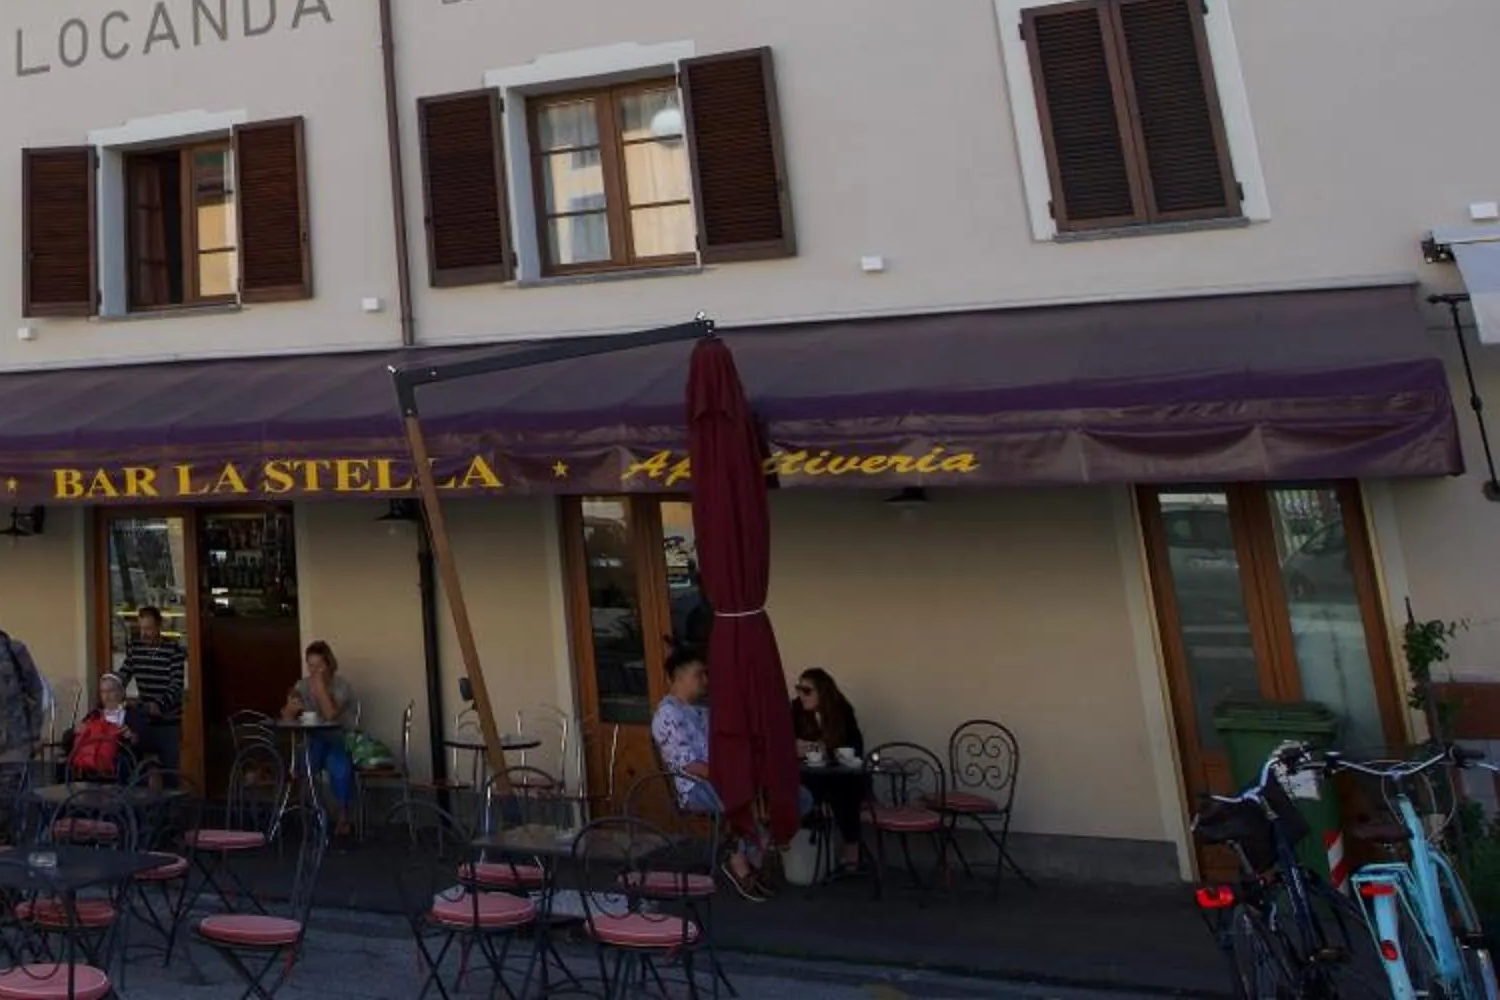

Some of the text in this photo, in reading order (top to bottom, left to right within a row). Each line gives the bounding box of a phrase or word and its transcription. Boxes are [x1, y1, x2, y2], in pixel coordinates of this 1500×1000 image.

[53, 467, 160, 498] BAR
[173, 462, 248, 495] LA
[621, 445, 981, 487] Apitiveria
